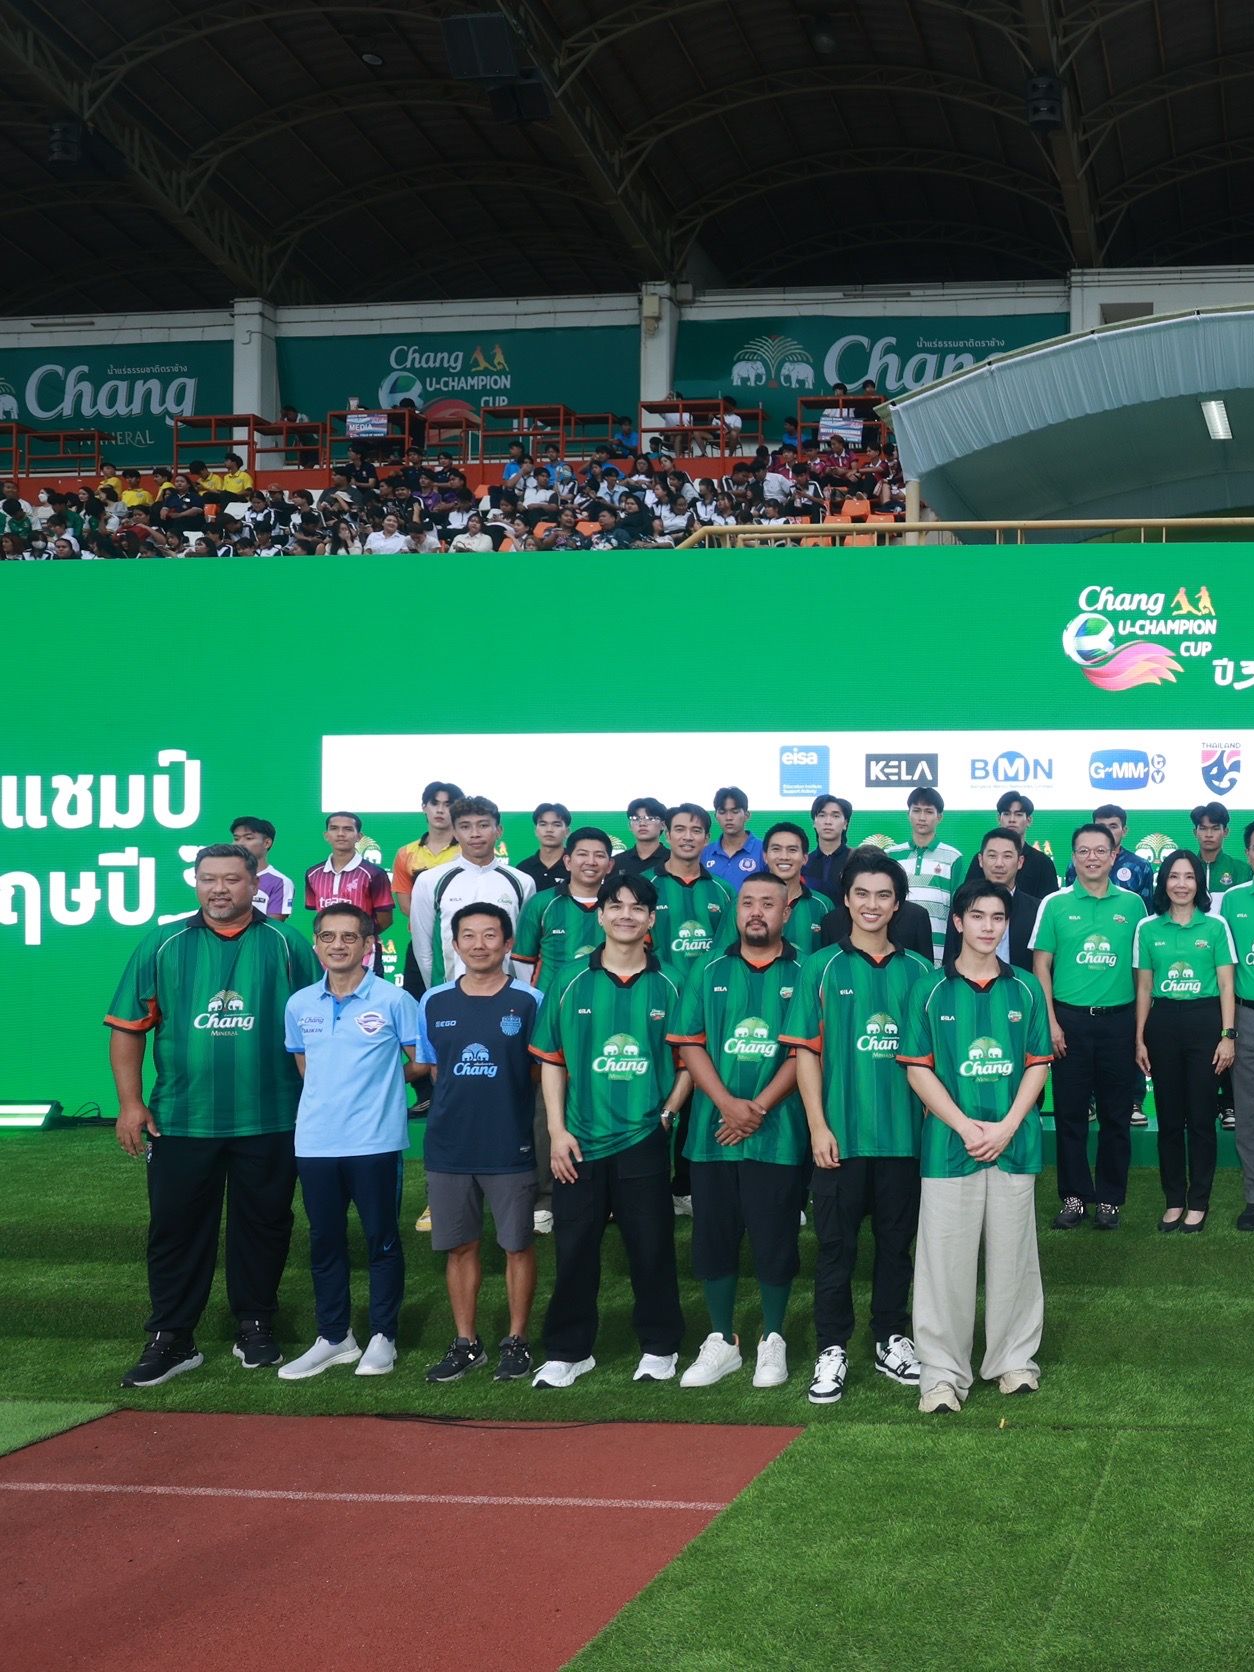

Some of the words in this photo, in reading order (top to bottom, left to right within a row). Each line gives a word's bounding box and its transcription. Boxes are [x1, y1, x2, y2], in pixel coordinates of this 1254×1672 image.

[389, 345, 464, 373] Chang
[823, 334, 1005, 393] Cha
[426, 375, 511, 391] U-CHAMPION
[25, 364, 198, 428] Chang
[1078, 585, 1166, 616] Chang
[1118, 619, 1218, 635] U-CHAMPION
[1179, 641, 1213, 657] CUP
[1212, 657, 1235, 686] ปี
[781, 748, 818, 766] eisa
[870, 760, 933, 781] KELA
[970, 757, 1053, 780] BMN
[1076, 951, 1117, 967] Chang
[1160, 979, 1201, 993] Chang
[193, 1013, 255, 1031] Chang
[723, 1038, 777, 1057] Chang
[856, 1035, 899, 1051] Chan
[453, 1062, 498, 1078] Chang
[592, 1056, 649, 1075] Chang
[960, 1060, 1014, 1076] Chang
